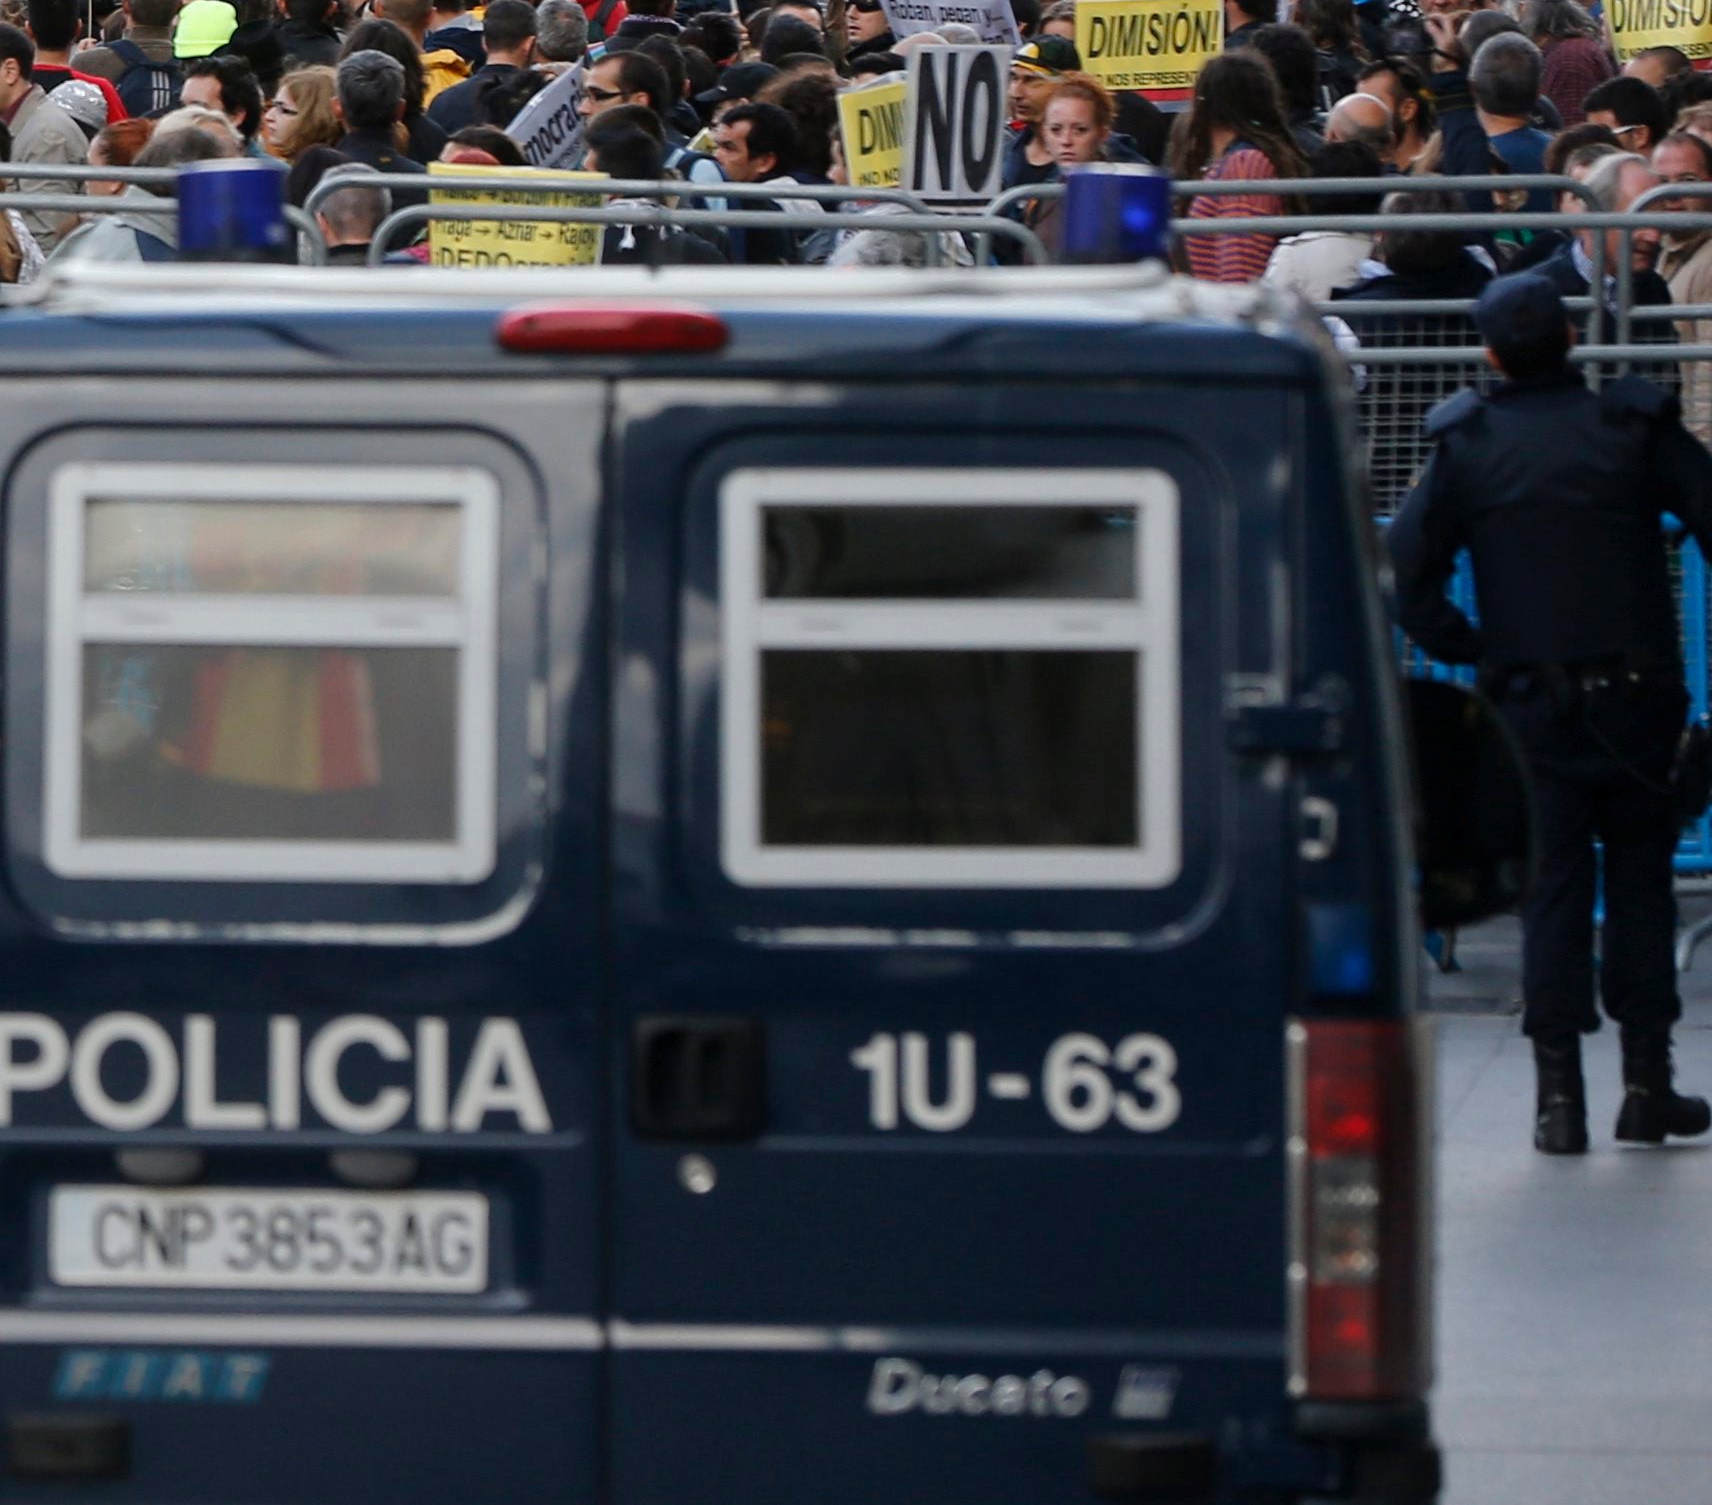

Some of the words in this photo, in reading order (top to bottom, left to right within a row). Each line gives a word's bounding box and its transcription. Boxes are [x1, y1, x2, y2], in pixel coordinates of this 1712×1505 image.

[1088, 3, 1220, 59] DIMISIÓN!
[1106, 72, 1132, 86] NOS
[913, 51, 1000, 193] NO
[91, 1201, 475, 1279] CNP3853AG
[56, 1352, 269, 1404] FIAT
[867, 1355, 1091, 1418] Ducato
